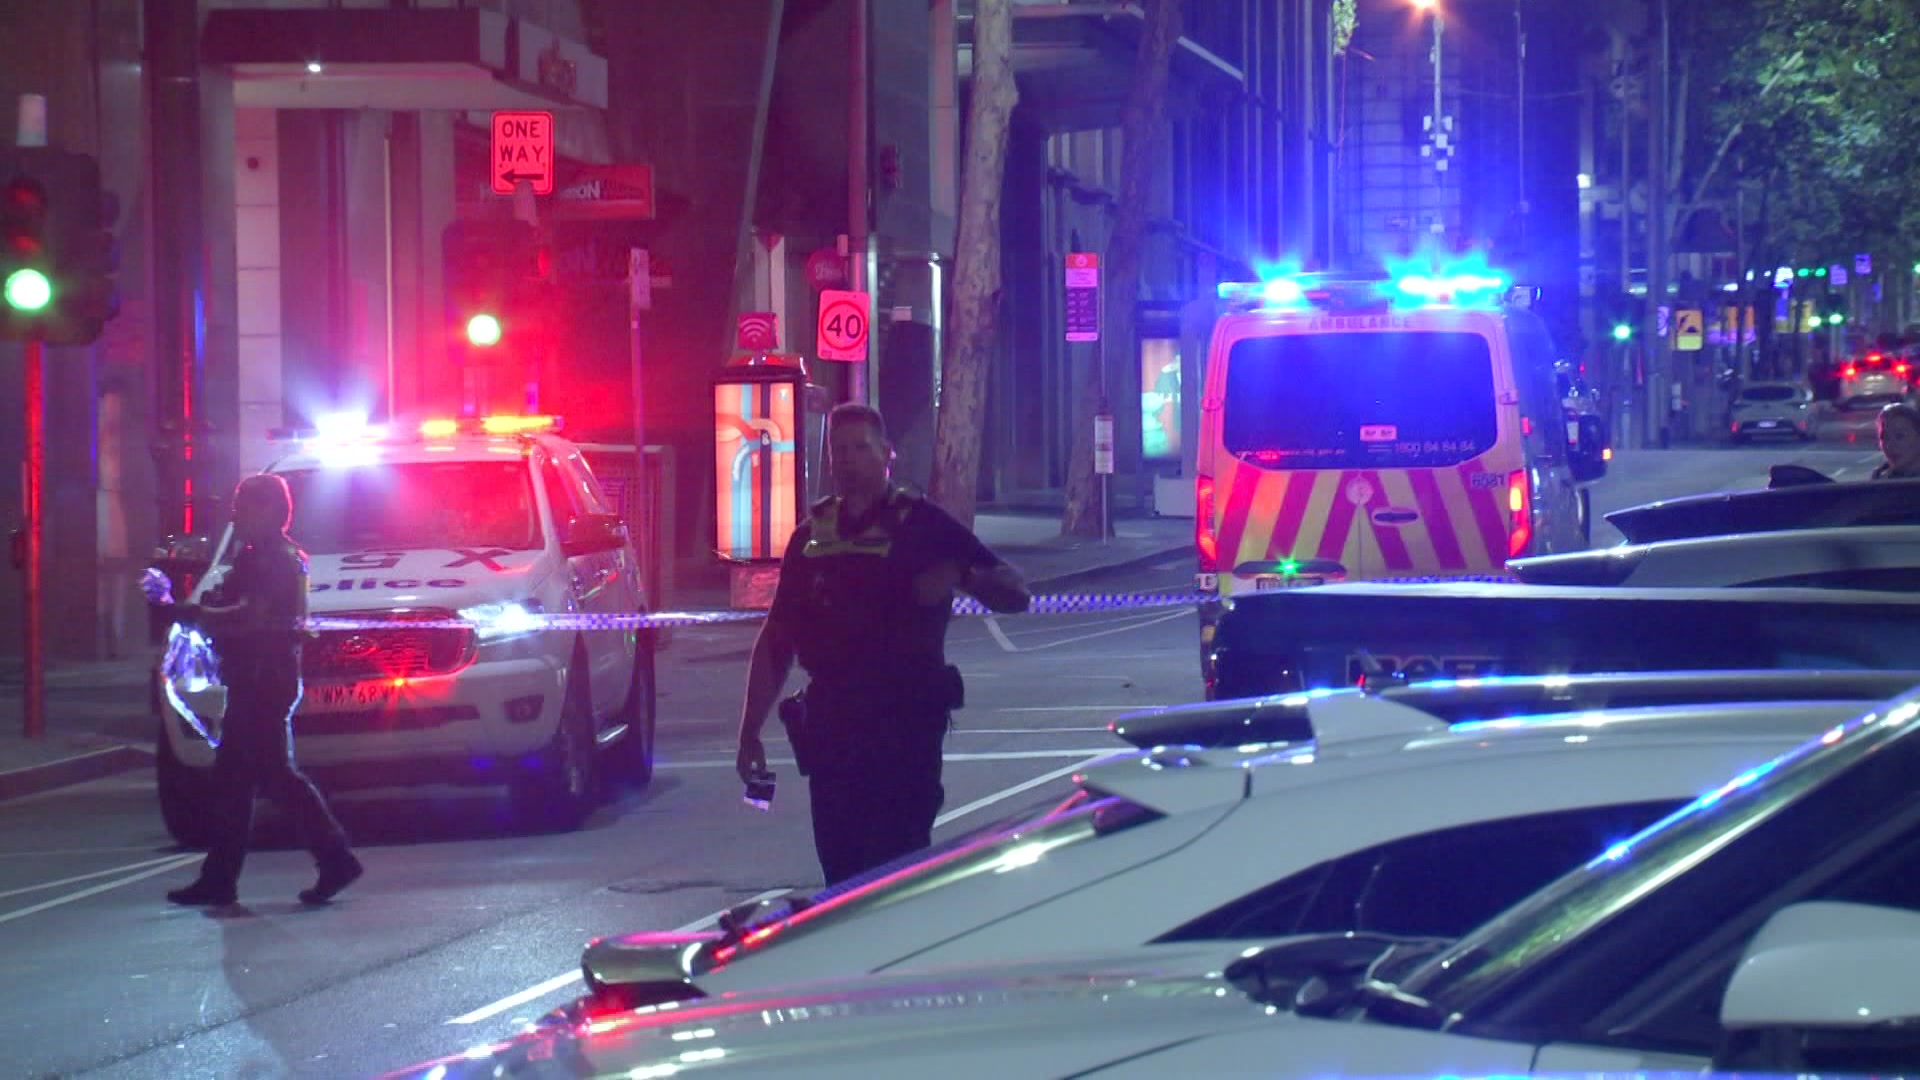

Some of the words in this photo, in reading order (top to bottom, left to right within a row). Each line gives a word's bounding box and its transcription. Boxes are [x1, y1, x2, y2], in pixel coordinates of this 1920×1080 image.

[502, 120, 541, 138] ONE
[500, 144, 544, 162] WAY
[826, 313, 861, 339] 40
[1307, 316, 1416, 330] AMBULANCE
[308, 578, 466, 591] olice
